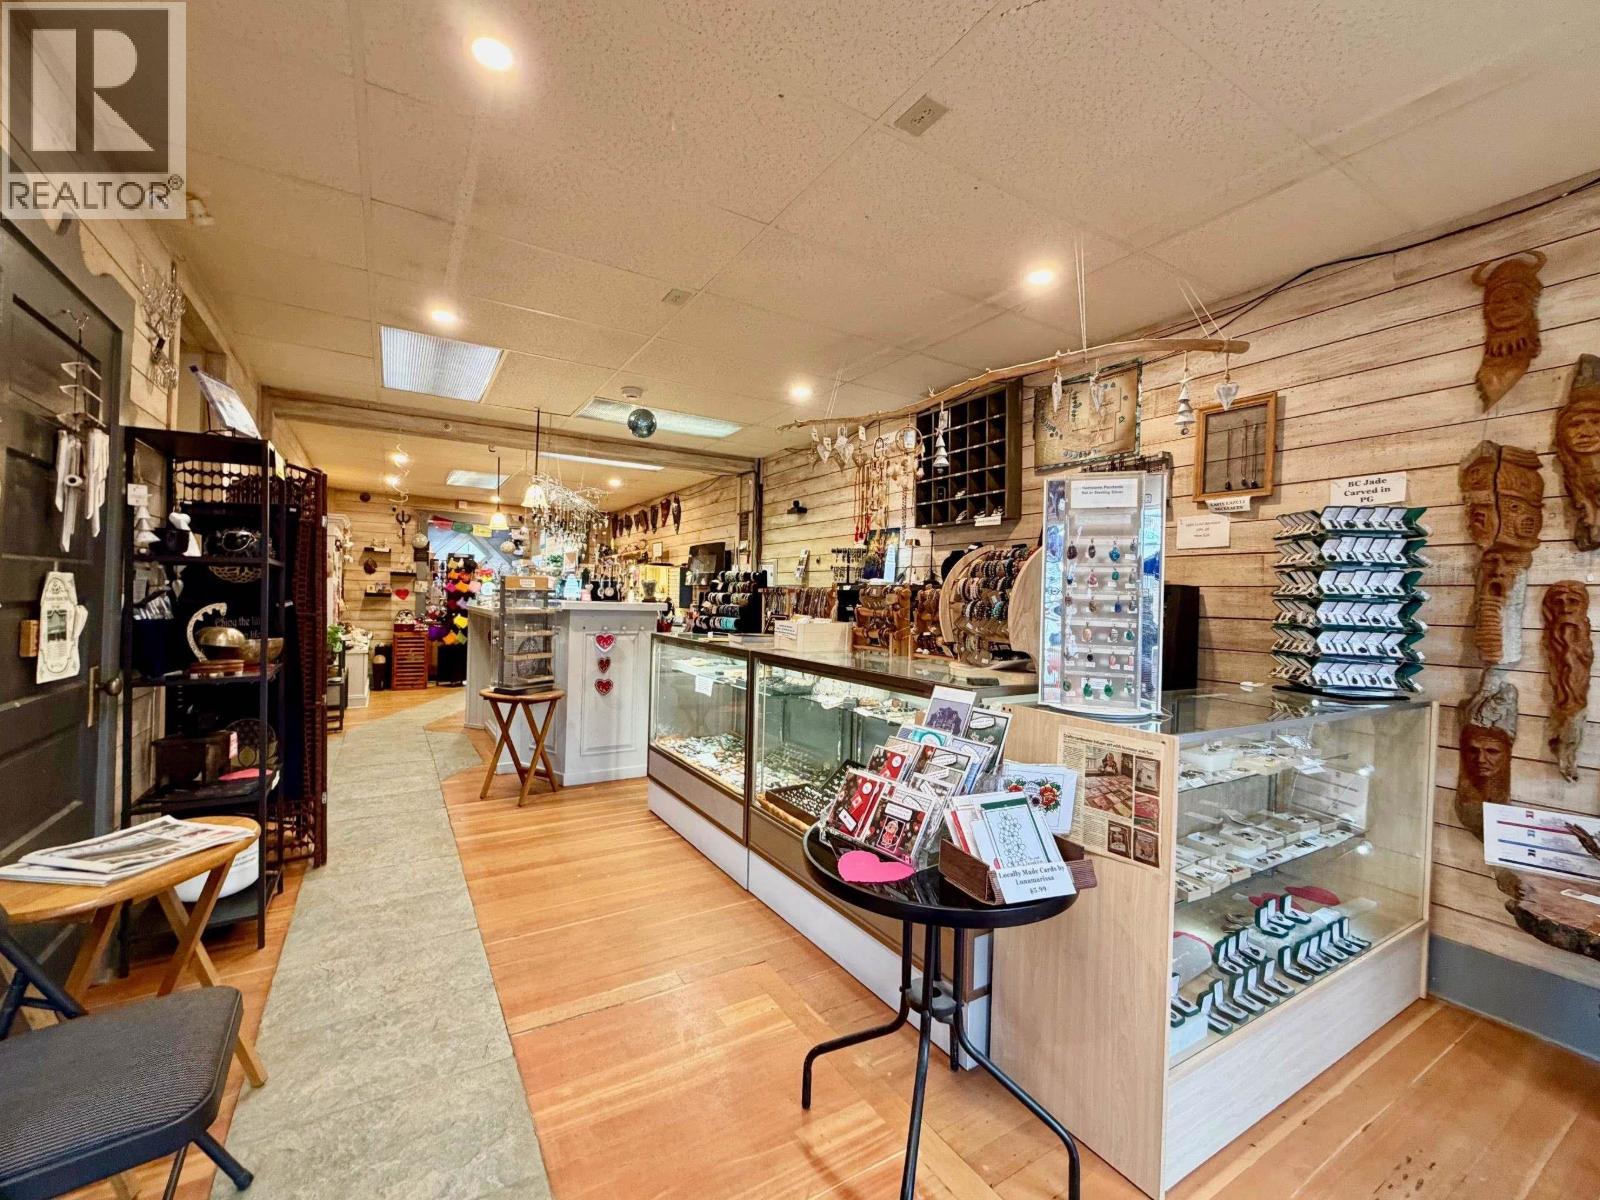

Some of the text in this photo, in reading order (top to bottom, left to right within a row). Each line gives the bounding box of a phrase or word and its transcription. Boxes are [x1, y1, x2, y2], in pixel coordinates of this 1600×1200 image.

[1363, 478, 1388, 486] Jade
[1344, 487, 1378, 496] Carved
[998, 864, 1065, 880] Locally Made Cards by
